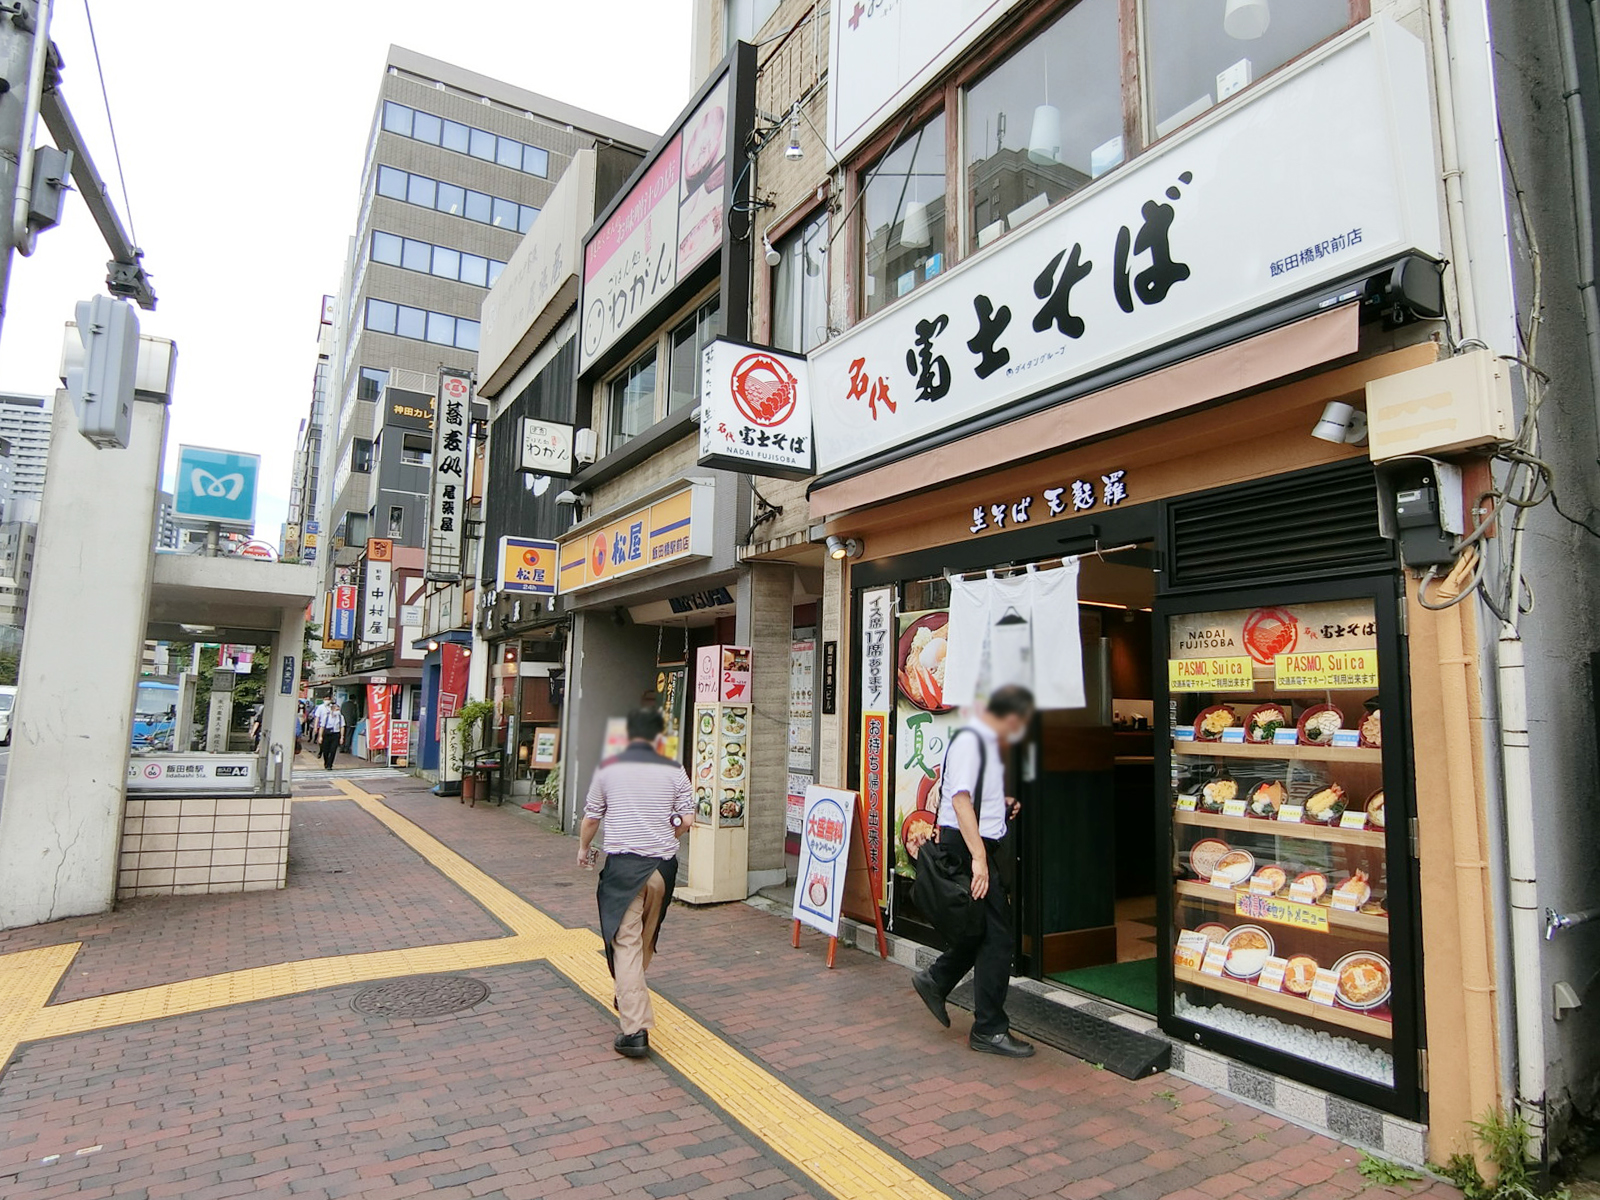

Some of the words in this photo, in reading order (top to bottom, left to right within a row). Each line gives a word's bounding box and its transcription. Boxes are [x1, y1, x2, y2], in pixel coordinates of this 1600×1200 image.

[1268, 227, 1364, 278] 飯田橋駅前店
[1014, 345, 1067, 374] ダイタングループ
[846, 356, 897, 421] 名代
[393, 404, 435, 420] 神田カレ
[717, 422, 735, 443] 名代
[726, 446, 754, 458] NADAI
[757, 452, 796, 465] FUJISOBA
[440, 484, 457, 532] 尾張屋
[969, 496, 1031, 534] 生そば
[611, 520, 643, 567] 松屋
[651, 535, 690, 562] 飯田橋駅前店
[516, 567, 545, 583] 松屋
[367, 587, 384, 635] 中村屋
[1179, 638, 1235, 650] FUJISOBA
[1189, 629, 1226, 640] NADAI
[1212, 660, 1242, 675] Suica
[1328, 654, 1365, 671] Suica
[371, 685, 387, 747] カレーライス
[166, 764, 205, 773] 飯田橋駅
[231, 767, 248, 776] A4
[808, 814, 845, 846] 大盛無料
